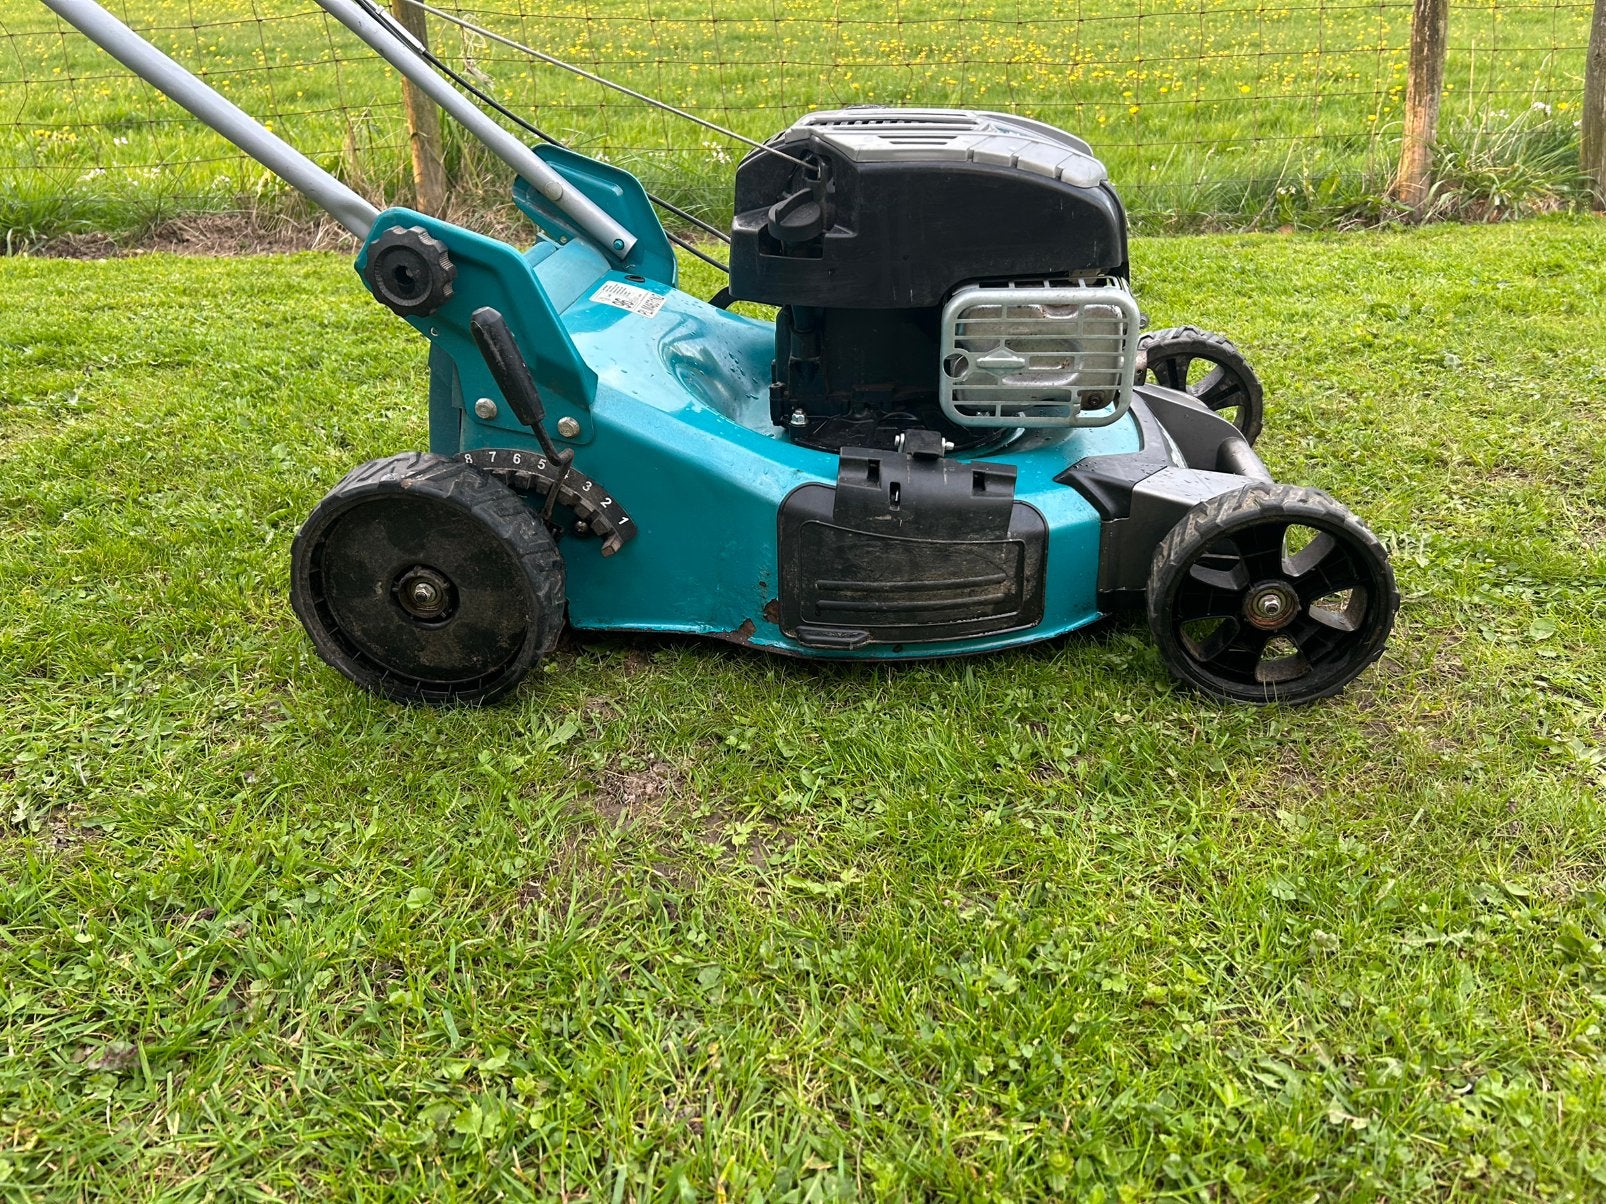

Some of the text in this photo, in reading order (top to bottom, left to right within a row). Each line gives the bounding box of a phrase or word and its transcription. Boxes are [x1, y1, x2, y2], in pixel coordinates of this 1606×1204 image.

[464, 451, 630, 525] 8 7 6 5 3 2 1
